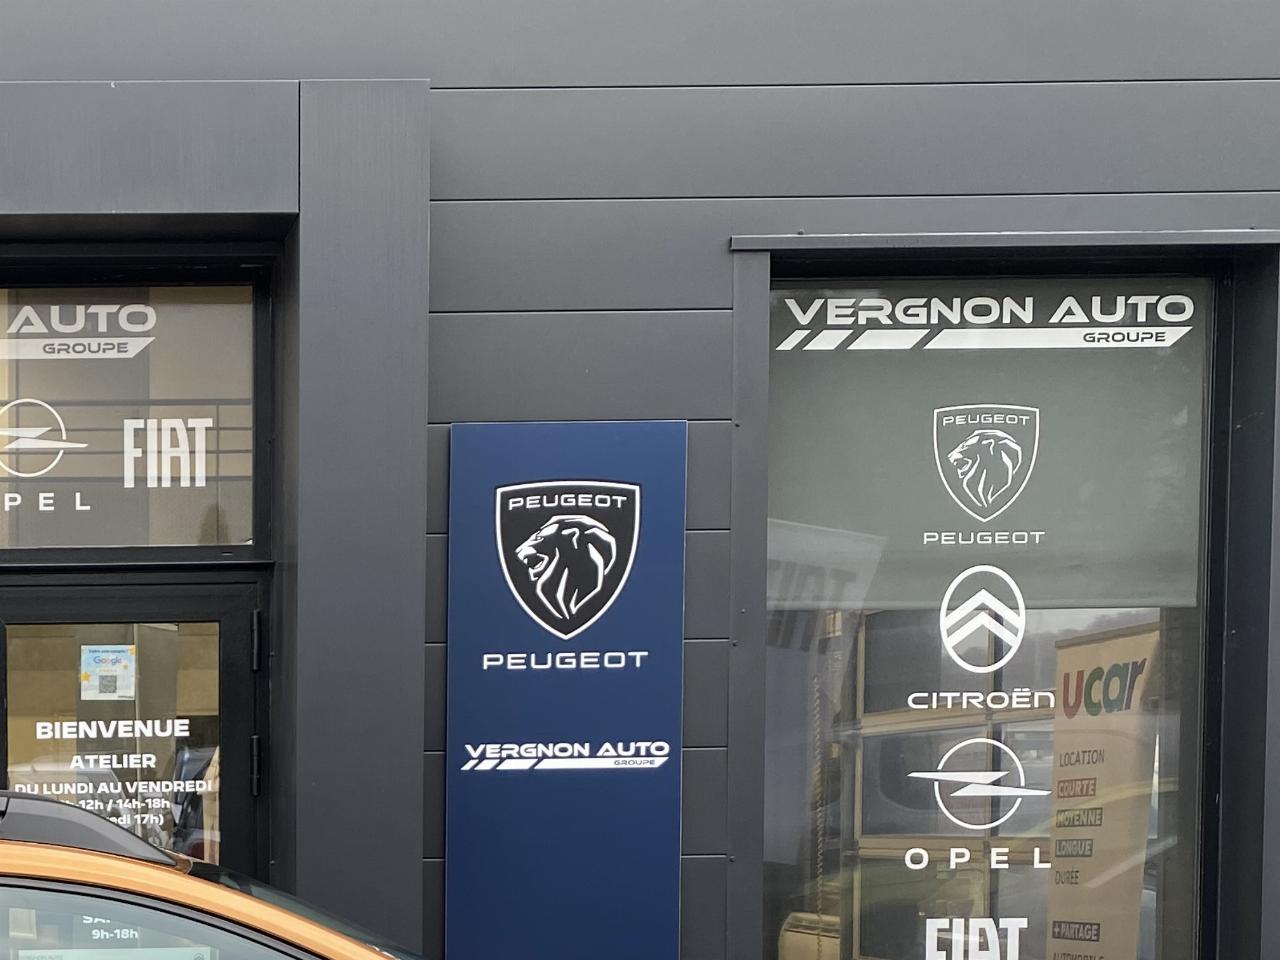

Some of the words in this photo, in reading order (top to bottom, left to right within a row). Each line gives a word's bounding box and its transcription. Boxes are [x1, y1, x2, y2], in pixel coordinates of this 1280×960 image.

[784, 296, 1033, 325] VERGNON
[1048, 295, 1195, 323] AUTO
[7, 304, 157, 334] AUTO
[1083, 332, 1166, 343] GROUPE
[42, 341, 129, 355] GROUPE
[943, 414, 1030, 426] PEUGEOT
[123, 418, 213, 489] FIAT
[509, 494, 627, 510] PEUGEOT
[923, 531, 1045, 545] PEUGEOT
[483, 651, 648, 670] PEUGEOT
[907, 688, 1055, 709] CITROËN
[35, 719, 190, 740] BIENVENUE
[464, 743, 589, 758] VERGNON
[597, 741, 669, 756] AUTO
[70, 753, 156, 769] ATELIER
[1059, 749, 1105, 768] LOCATION
[14, 784, 39, 794] DU
[43, 782, 93, 795] LUNDI
[97, 781, 122, 794] AU
[125, 779, 212, 794] VENDREDI
[1059, 779, 1096, 797] COURTE
[117, 798, 170, 810] 14h-18h
[134, 814, 164, 826] 17h)
[1057, 808, 1102, 827] MOYENNE
[1056, 840, 1092, 857] LONGUE
[904, 847, 1052, 870] OPEL
[92, 929, 138, 939] 9h-18h
